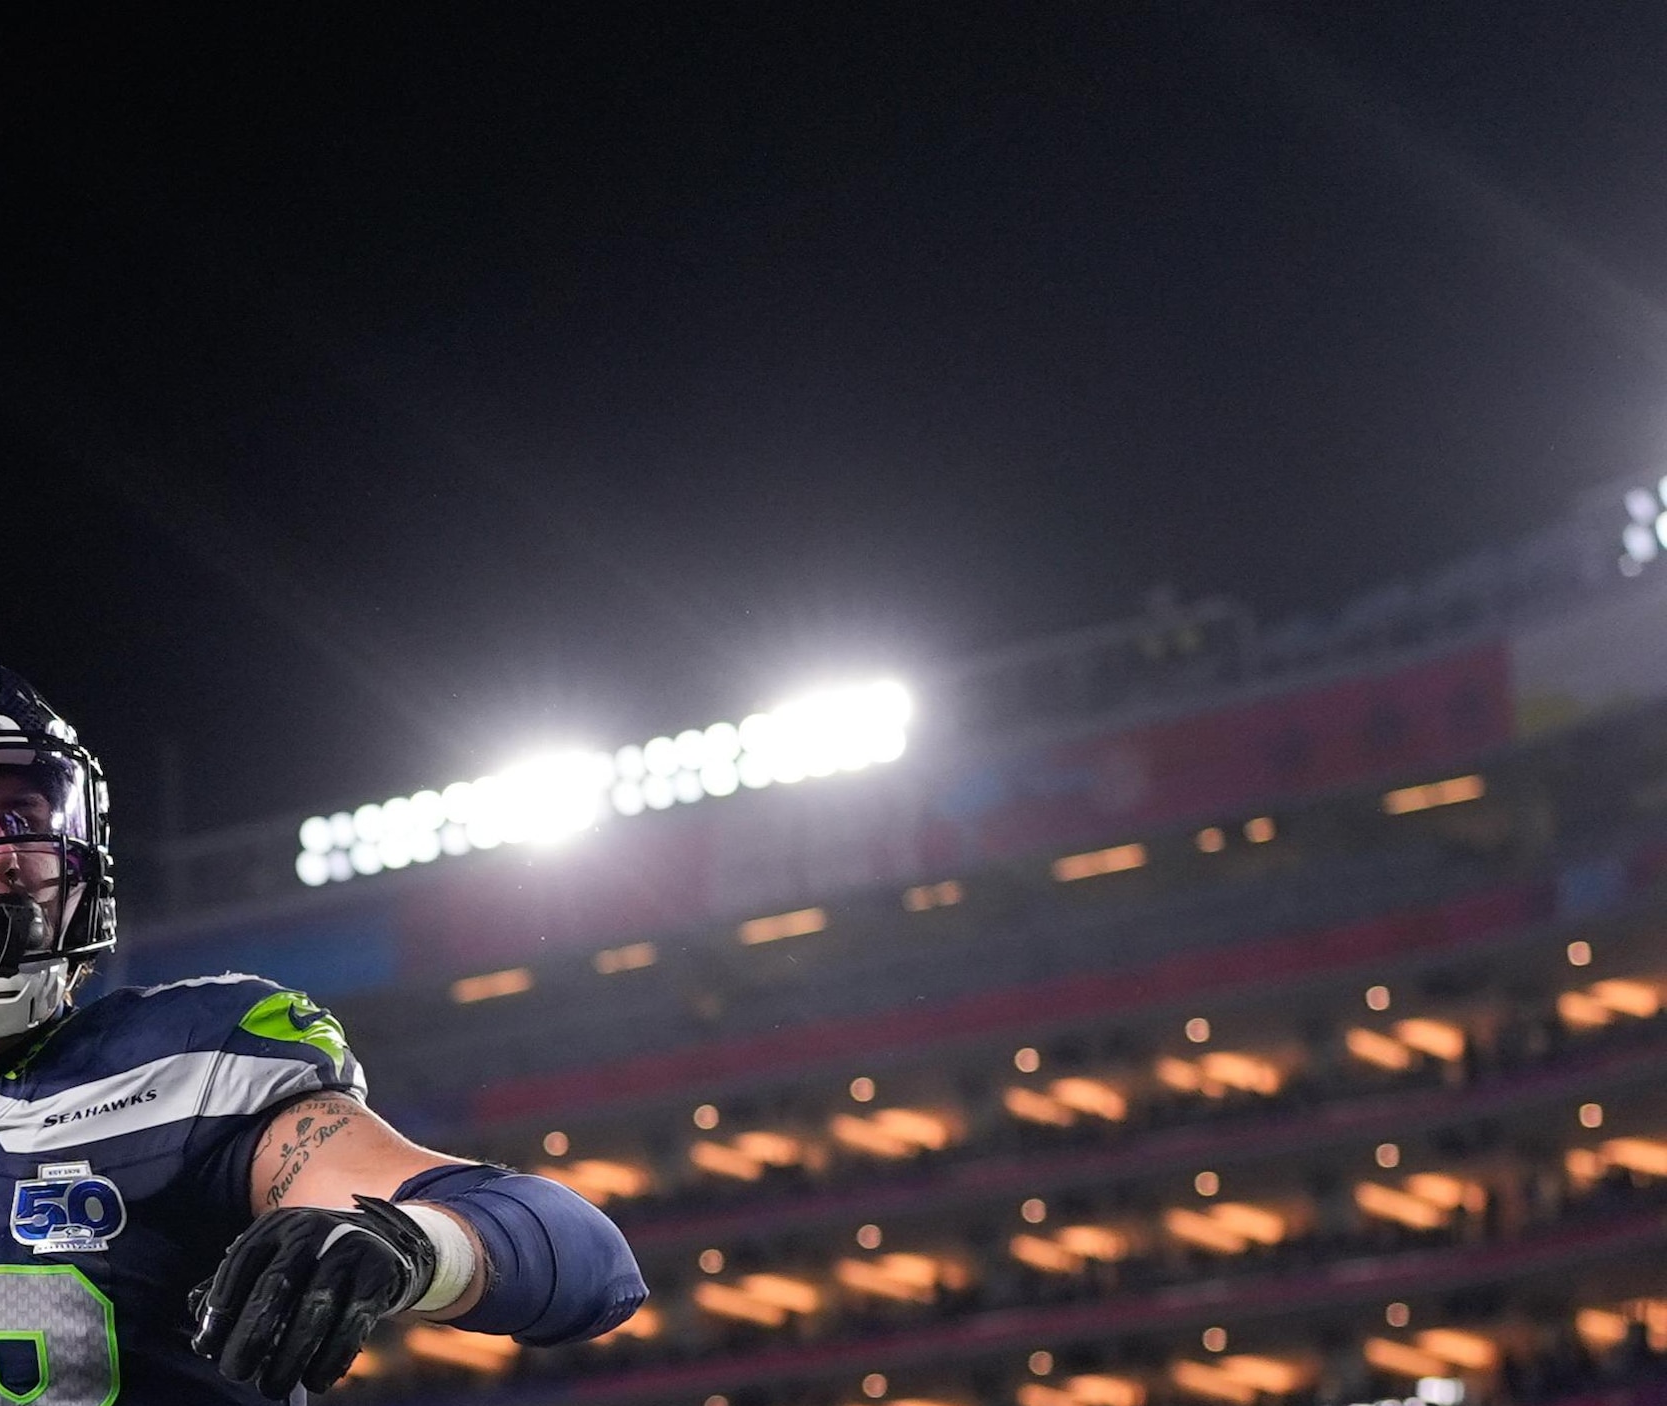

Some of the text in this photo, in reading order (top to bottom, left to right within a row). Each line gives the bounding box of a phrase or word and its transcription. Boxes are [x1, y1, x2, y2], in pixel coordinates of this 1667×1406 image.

[42, 1089, 157, 1128] SEAHAWKS
[313, 1116, 350, 1149] Rose
[14, 1181, 123, 1240] 50
